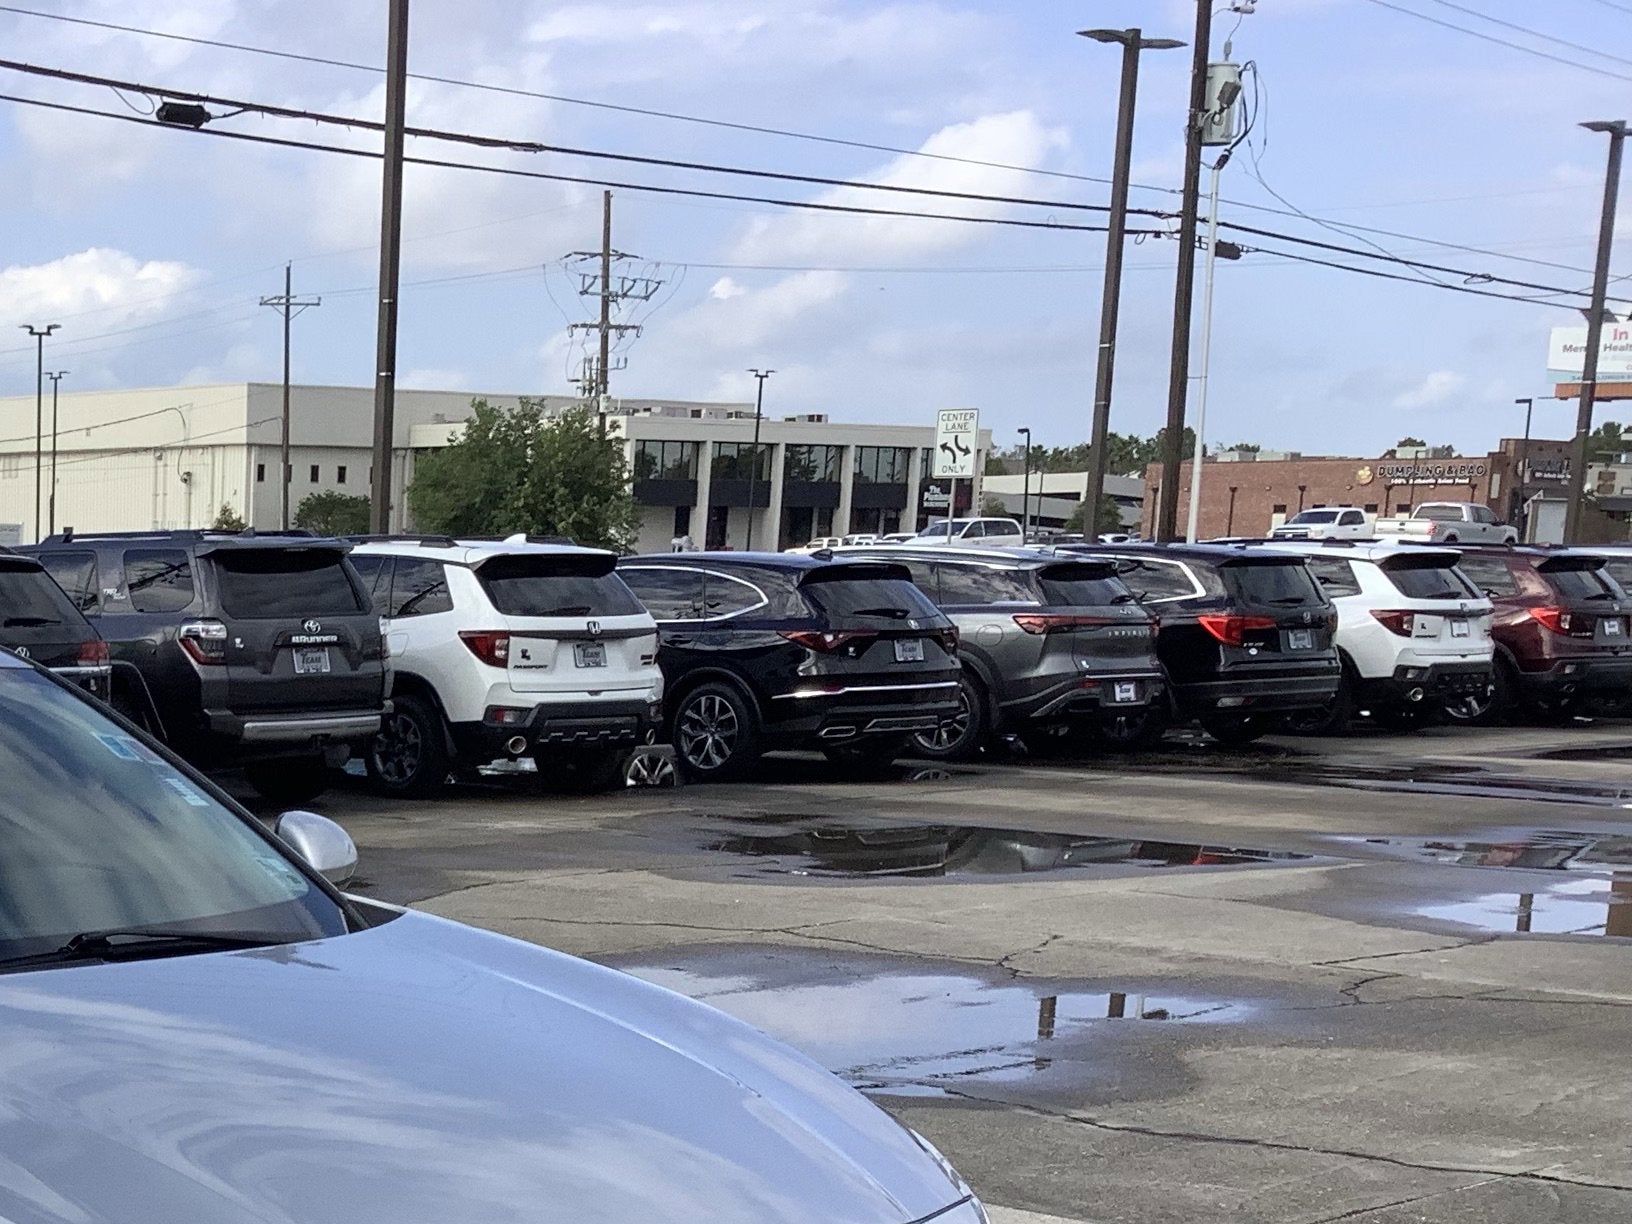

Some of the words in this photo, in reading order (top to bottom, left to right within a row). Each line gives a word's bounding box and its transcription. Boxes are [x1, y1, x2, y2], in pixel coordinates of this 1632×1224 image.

[1613, 328, 1629, 341] In
[941, 412, 976, 422] CENTER
[945, 422, 969, 431] LANE
[941, 465, 966, 474] ONLY
[1457, 464, 1486, 477] BAO
